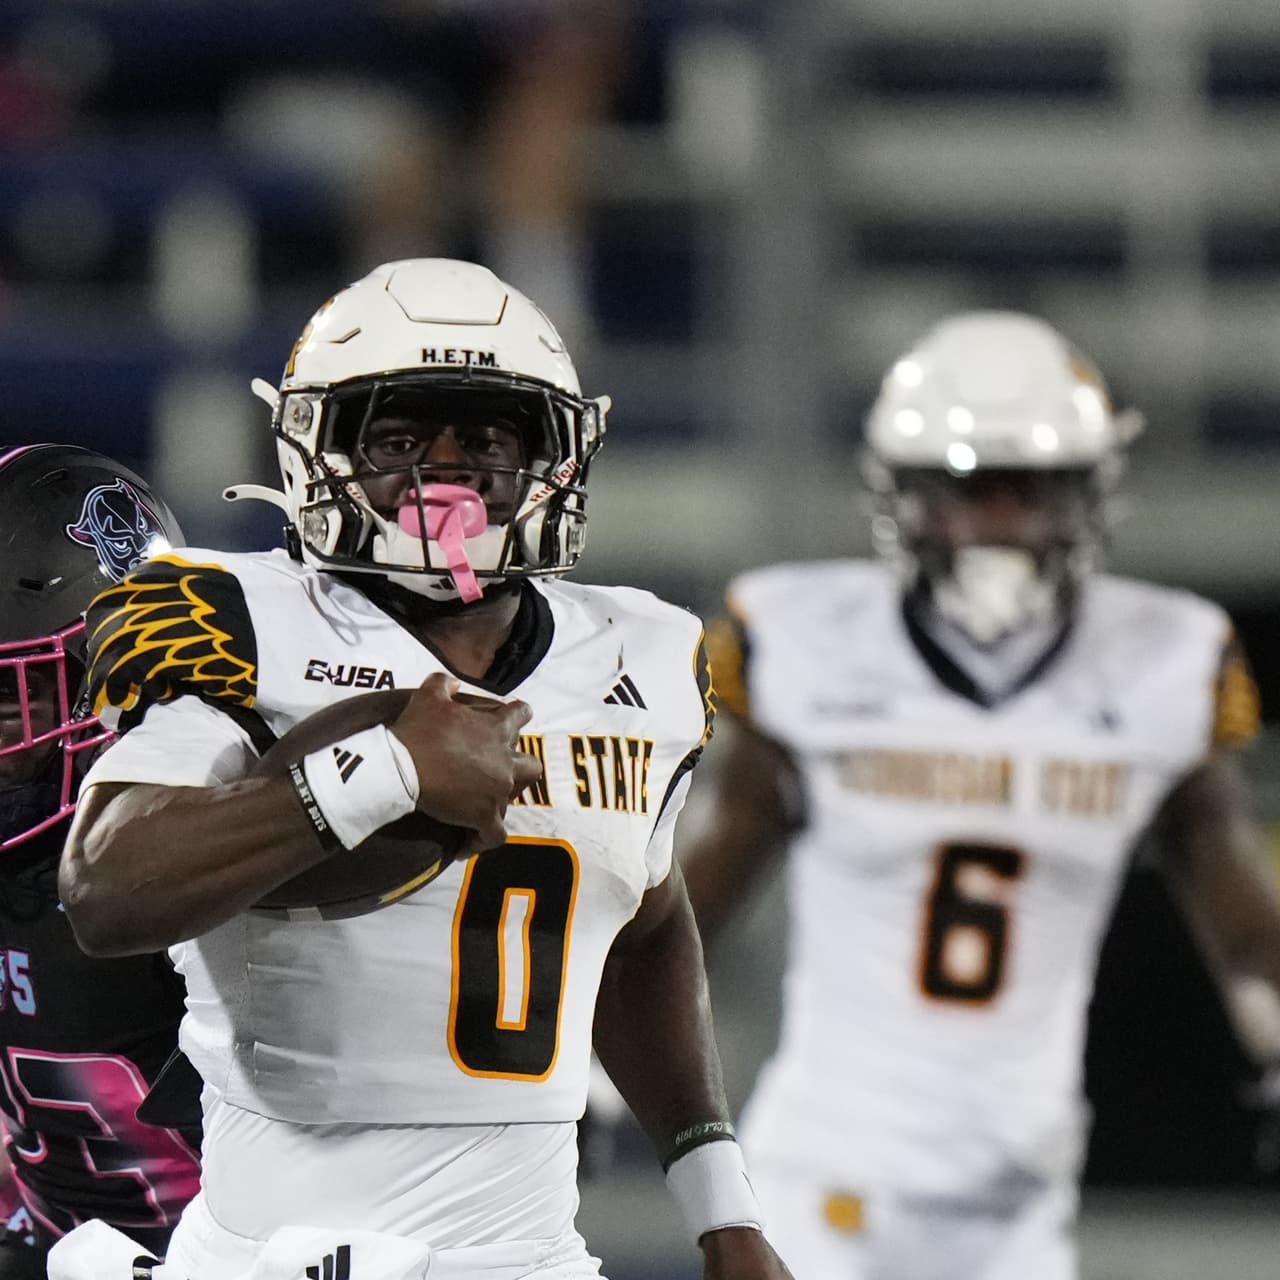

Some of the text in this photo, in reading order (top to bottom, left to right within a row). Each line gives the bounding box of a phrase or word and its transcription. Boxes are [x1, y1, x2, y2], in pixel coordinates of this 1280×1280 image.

[422, 348, 500, 367] H.E.T.M.
[568, 734, 654, 816] STATE
[447, 835, 580, 1081] 0
[917, 836, 1028, 1010] 6
